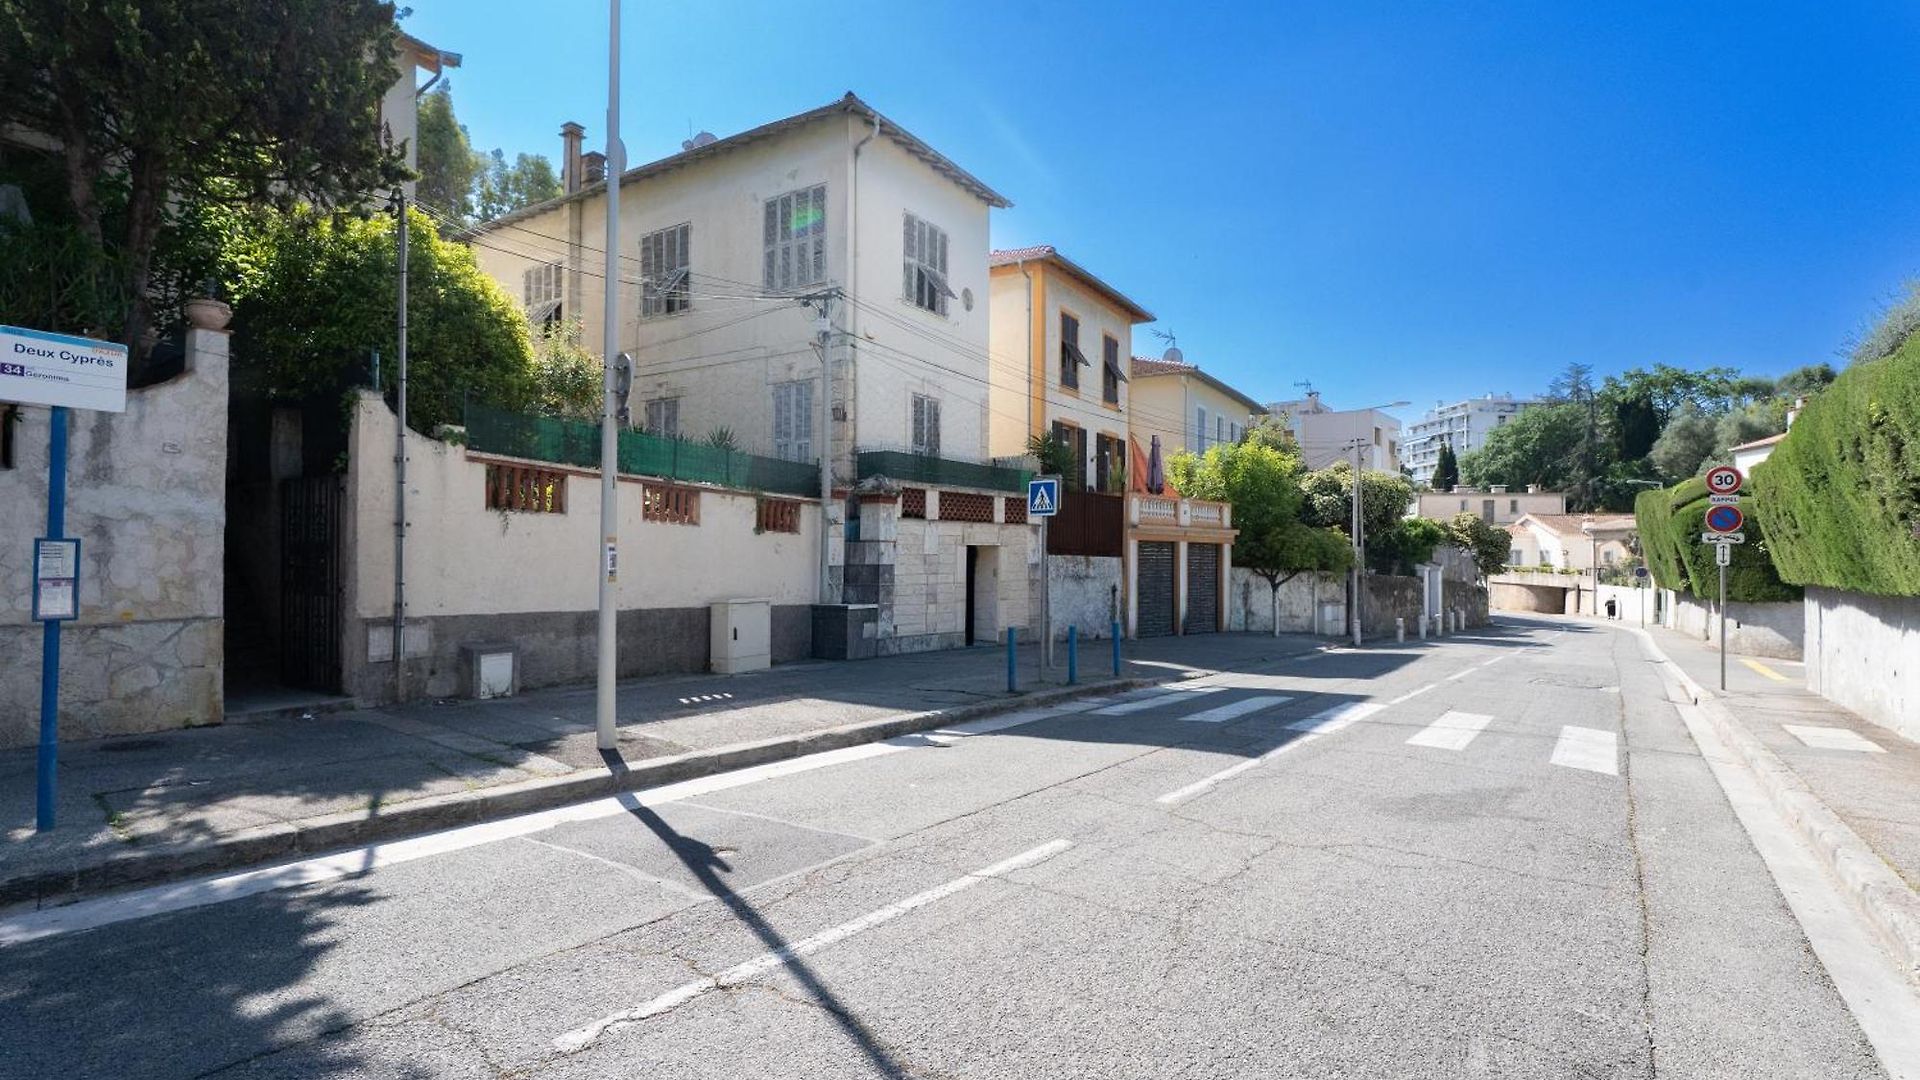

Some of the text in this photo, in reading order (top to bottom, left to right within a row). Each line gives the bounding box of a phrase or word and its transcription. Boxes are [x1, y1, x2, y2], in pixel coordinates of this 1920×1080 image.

[14, 343, 55, 358] Deux
[4, 364, 21, 374] 34
[1715, 474, 1734, 486] 30
